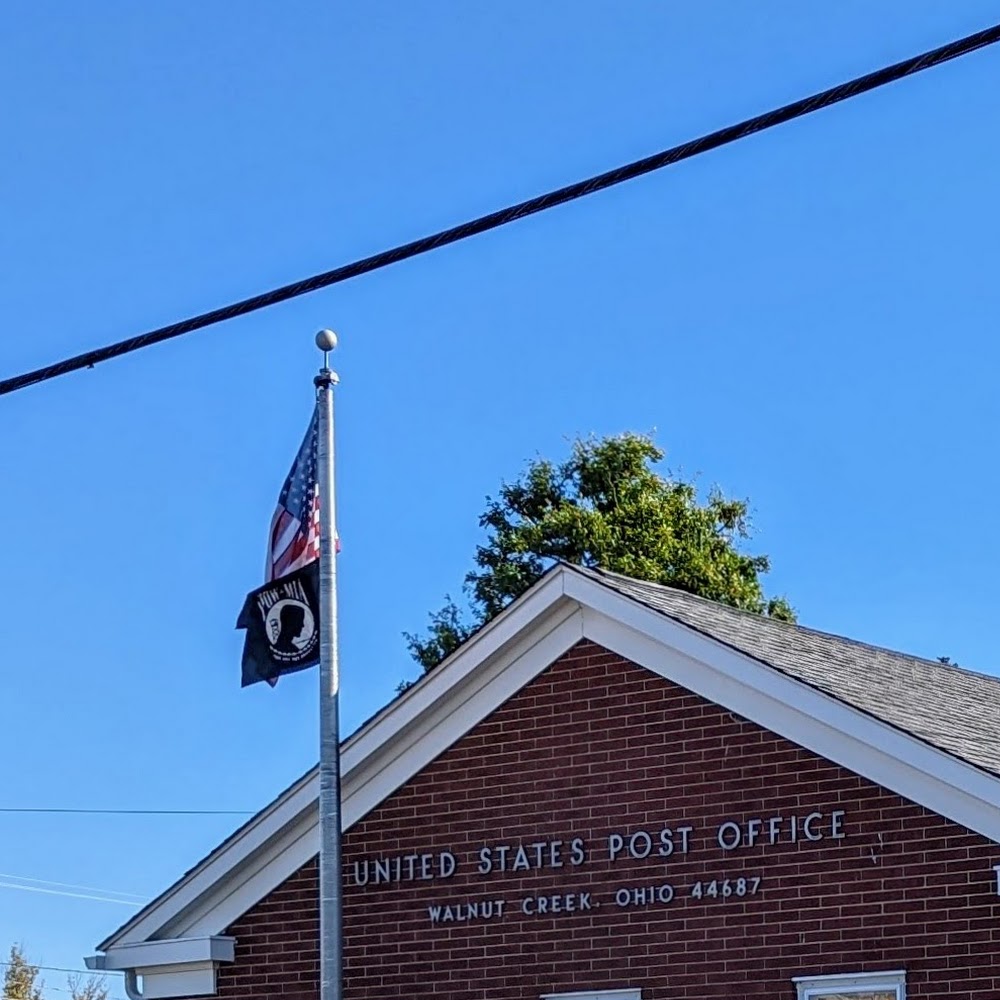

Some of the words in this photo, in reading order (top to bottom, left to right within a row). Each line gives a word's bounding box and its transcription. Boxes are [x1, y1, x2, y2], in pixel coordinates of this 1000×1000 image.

[354, 852, 456, 887] UNITED
[478, 839, 584, 875] STATES
[609, 826, 693, 860] POST
[718, 810, 846, 850] OFFICE
[428, 900, 505, 922] WALNUT
[616, 884, 674, 907] OHIO
[691, 876, 761, 899] 44687
